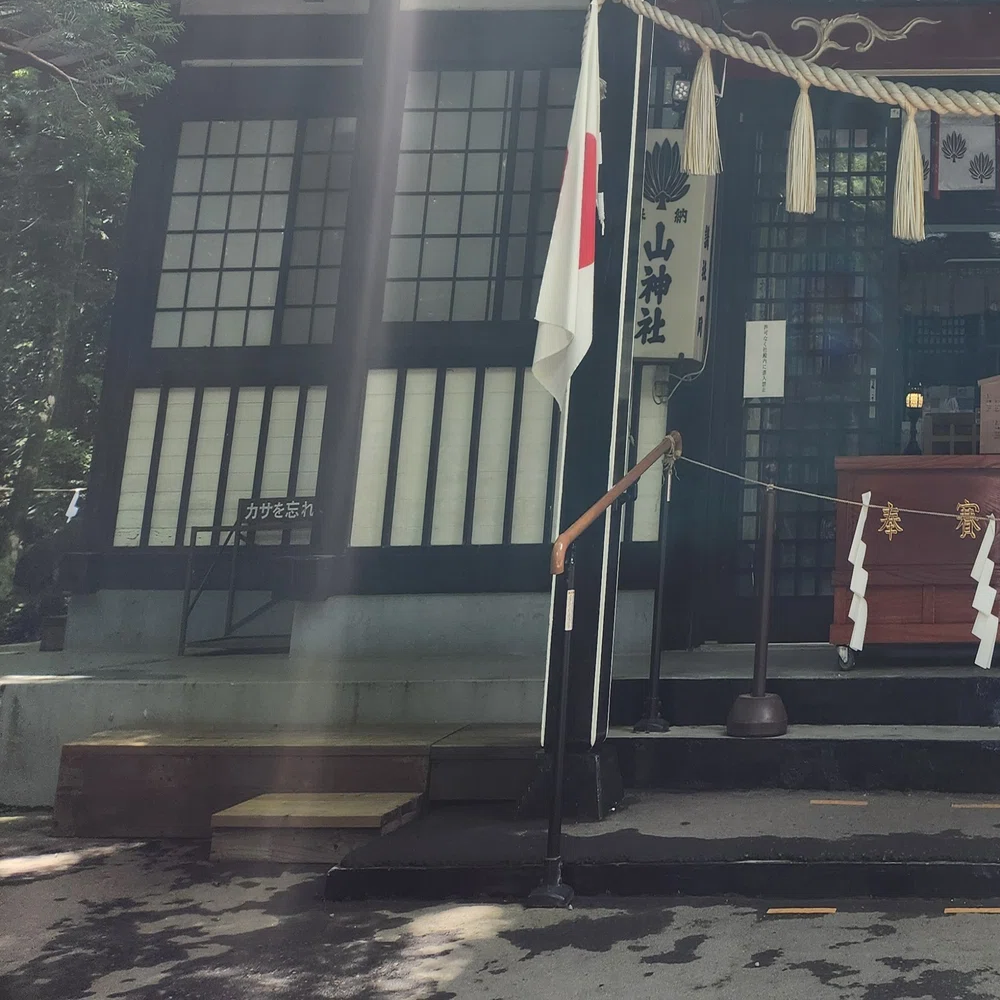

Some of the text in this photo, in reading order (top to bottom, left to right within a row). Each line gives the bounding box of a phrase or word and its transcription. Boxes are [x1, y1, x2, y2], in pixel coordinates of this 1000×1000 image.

[674, 208, 688, 224] 納
[634, 221, 675, 345] 山神社
[245, 501, 314, 519] カサを忘れ
[877, 498, 981, 541] 奉 賽
